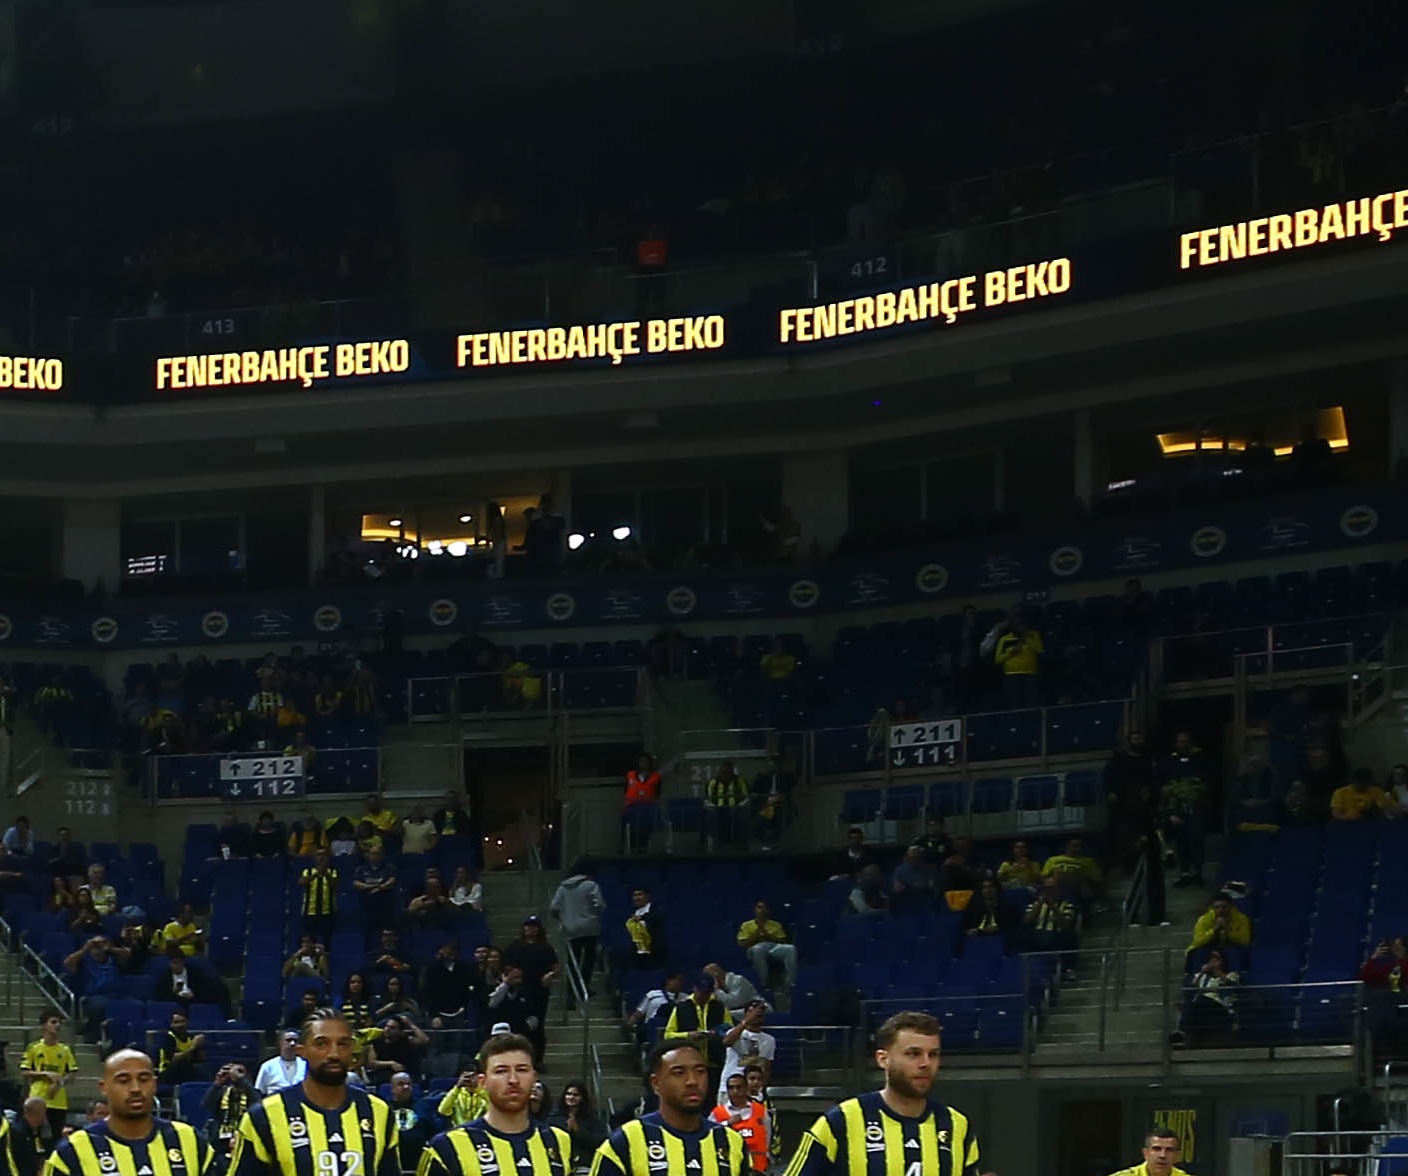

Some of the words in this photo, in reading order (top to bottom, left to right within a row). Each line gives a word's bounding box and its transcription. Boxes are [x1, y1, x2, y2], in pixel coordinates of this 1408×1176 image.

[850, 257, 888, 278] 412
[780, 275, 977, 343] FENERBAHÇE
[984, 257, 1071, 307] BEKO
[202, 318, 236, 335] 413
[457, 321, 640, 366] FENERBAHÇE
[647, 315, 724, 353] BEKO
[156, 345, 329, 389] FENERBAHÇE
[336, 340, 409, 376] BEKO
[914, 723, 955, 742] 211
[914, 745, 955, 766] 111
[253, 759, 296, 777] 212
[253, 780, 296, 796] 112
